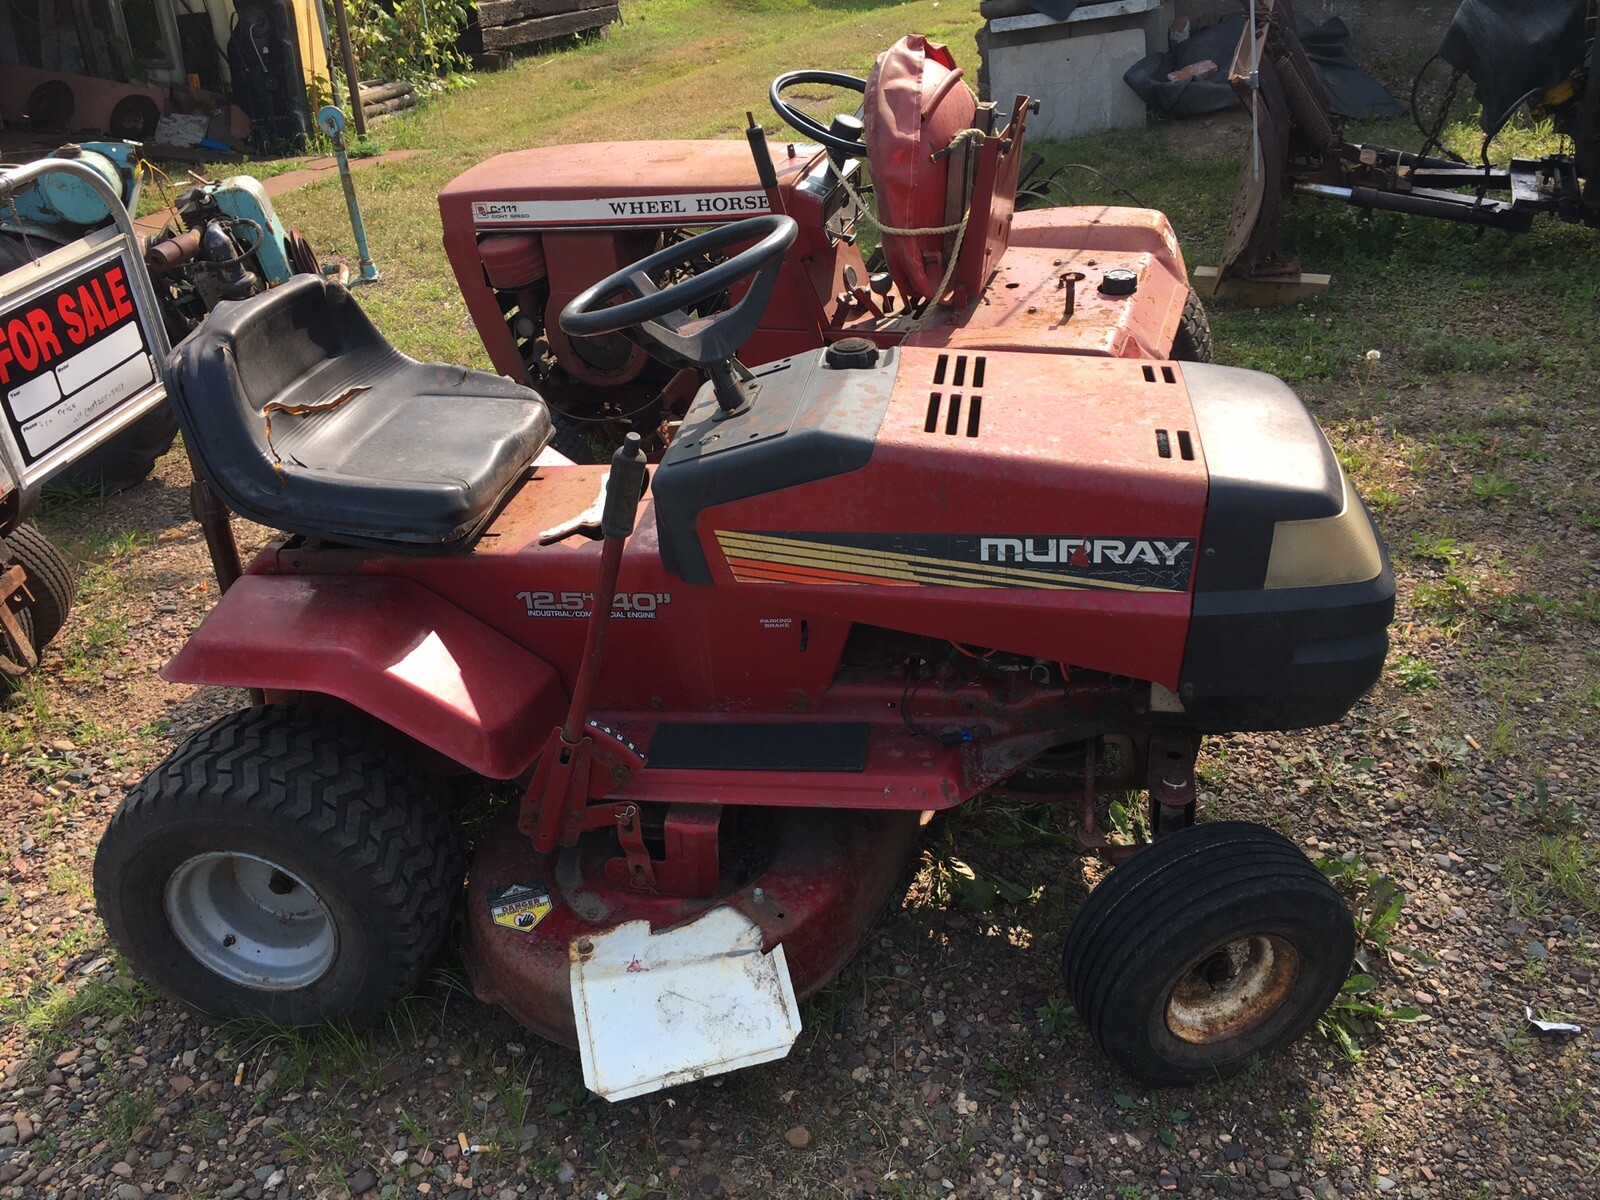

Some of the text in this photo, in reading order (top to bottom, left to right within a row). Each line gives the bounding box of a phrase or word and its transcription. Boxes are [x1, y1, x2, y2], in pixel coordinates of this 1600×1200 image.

[608, 196, 770, 215] WHEEL HORSE
[0, 266, 133, 384] FOR SALE
[57, 363, 70, 373] Model
[10, 390, 21, 398] Year
[23, 422, 38, 433] Phone
[980, 538, 1190, 565] MURRAY
[516, 592, 595, 610] 12.5H
[628, 611, 656, 619] ENGINE
[501, 898, 540, 913] DANGER
